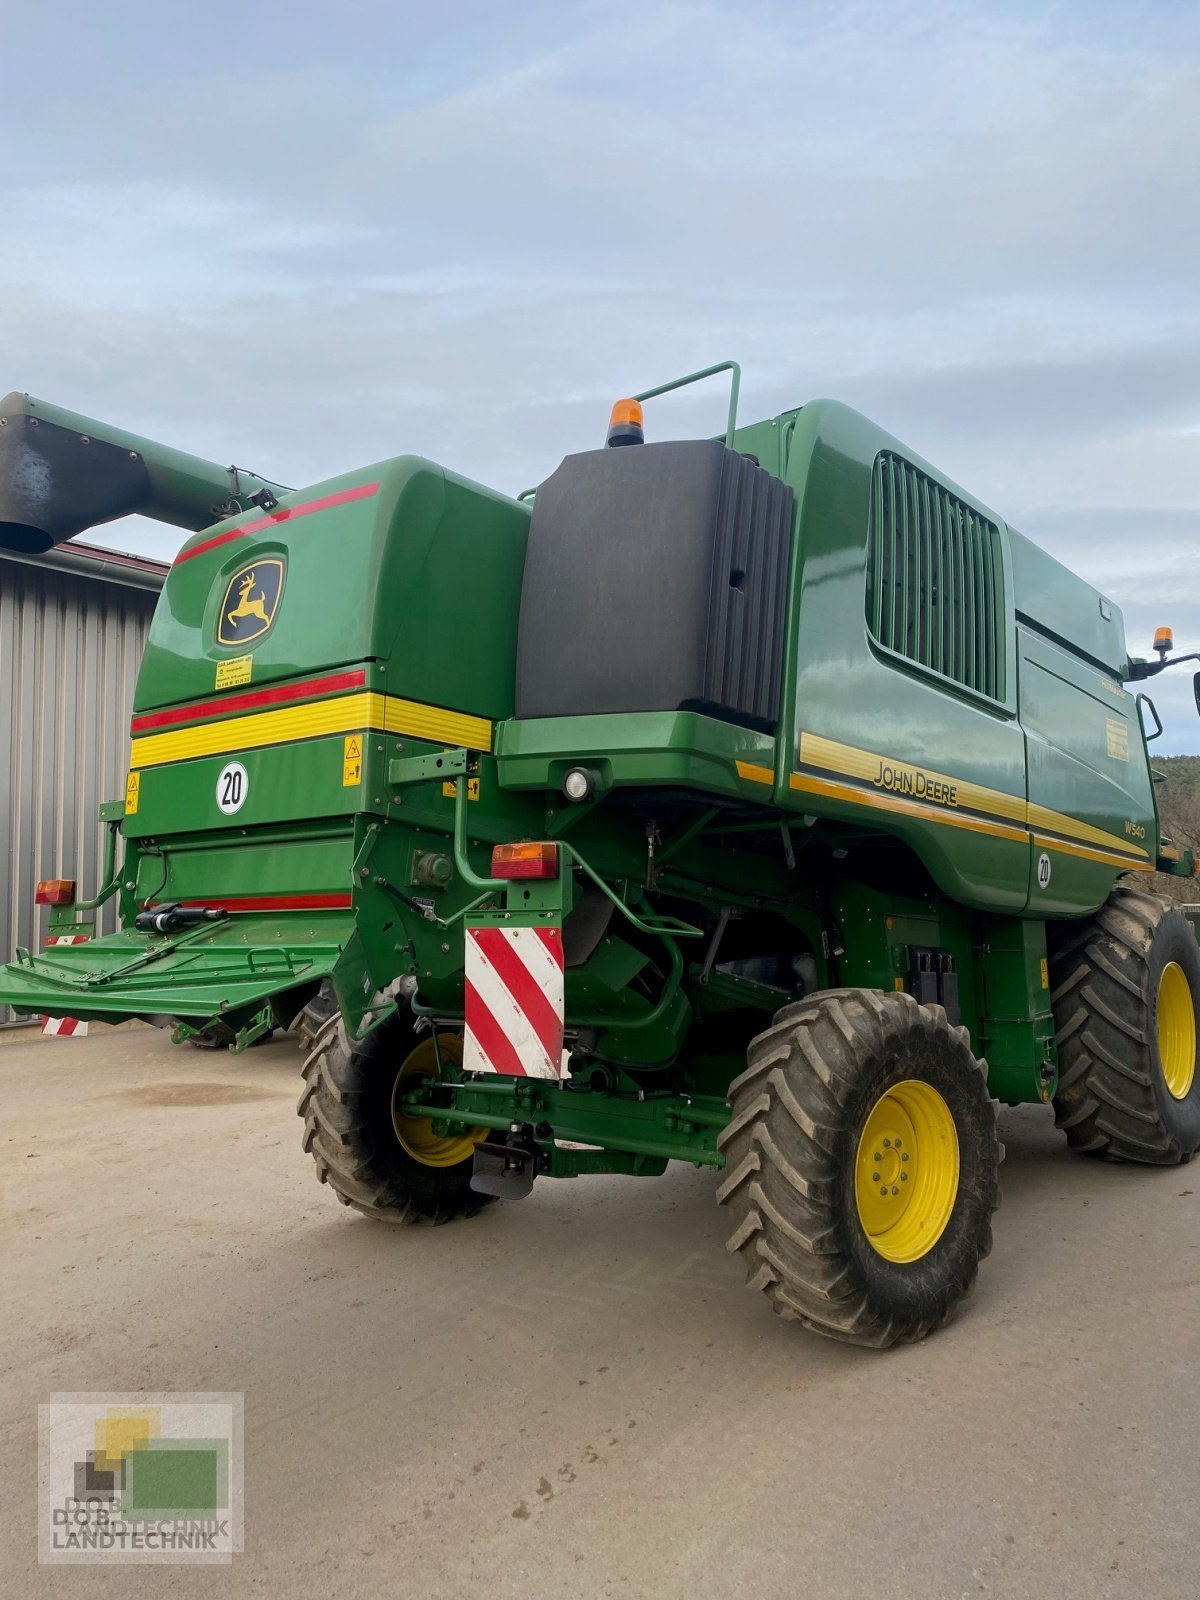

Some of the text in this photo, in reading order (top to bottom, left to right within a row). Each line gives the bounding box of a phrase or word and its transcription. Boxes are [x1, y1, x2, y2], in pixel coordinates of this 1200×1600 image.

[222, 770, 242, 805] 20
[874, 761, 957, 805] JOHN DEERE
[1125, 820, 1145, 839] W540
[1040, 859, 1049, 882] 20
